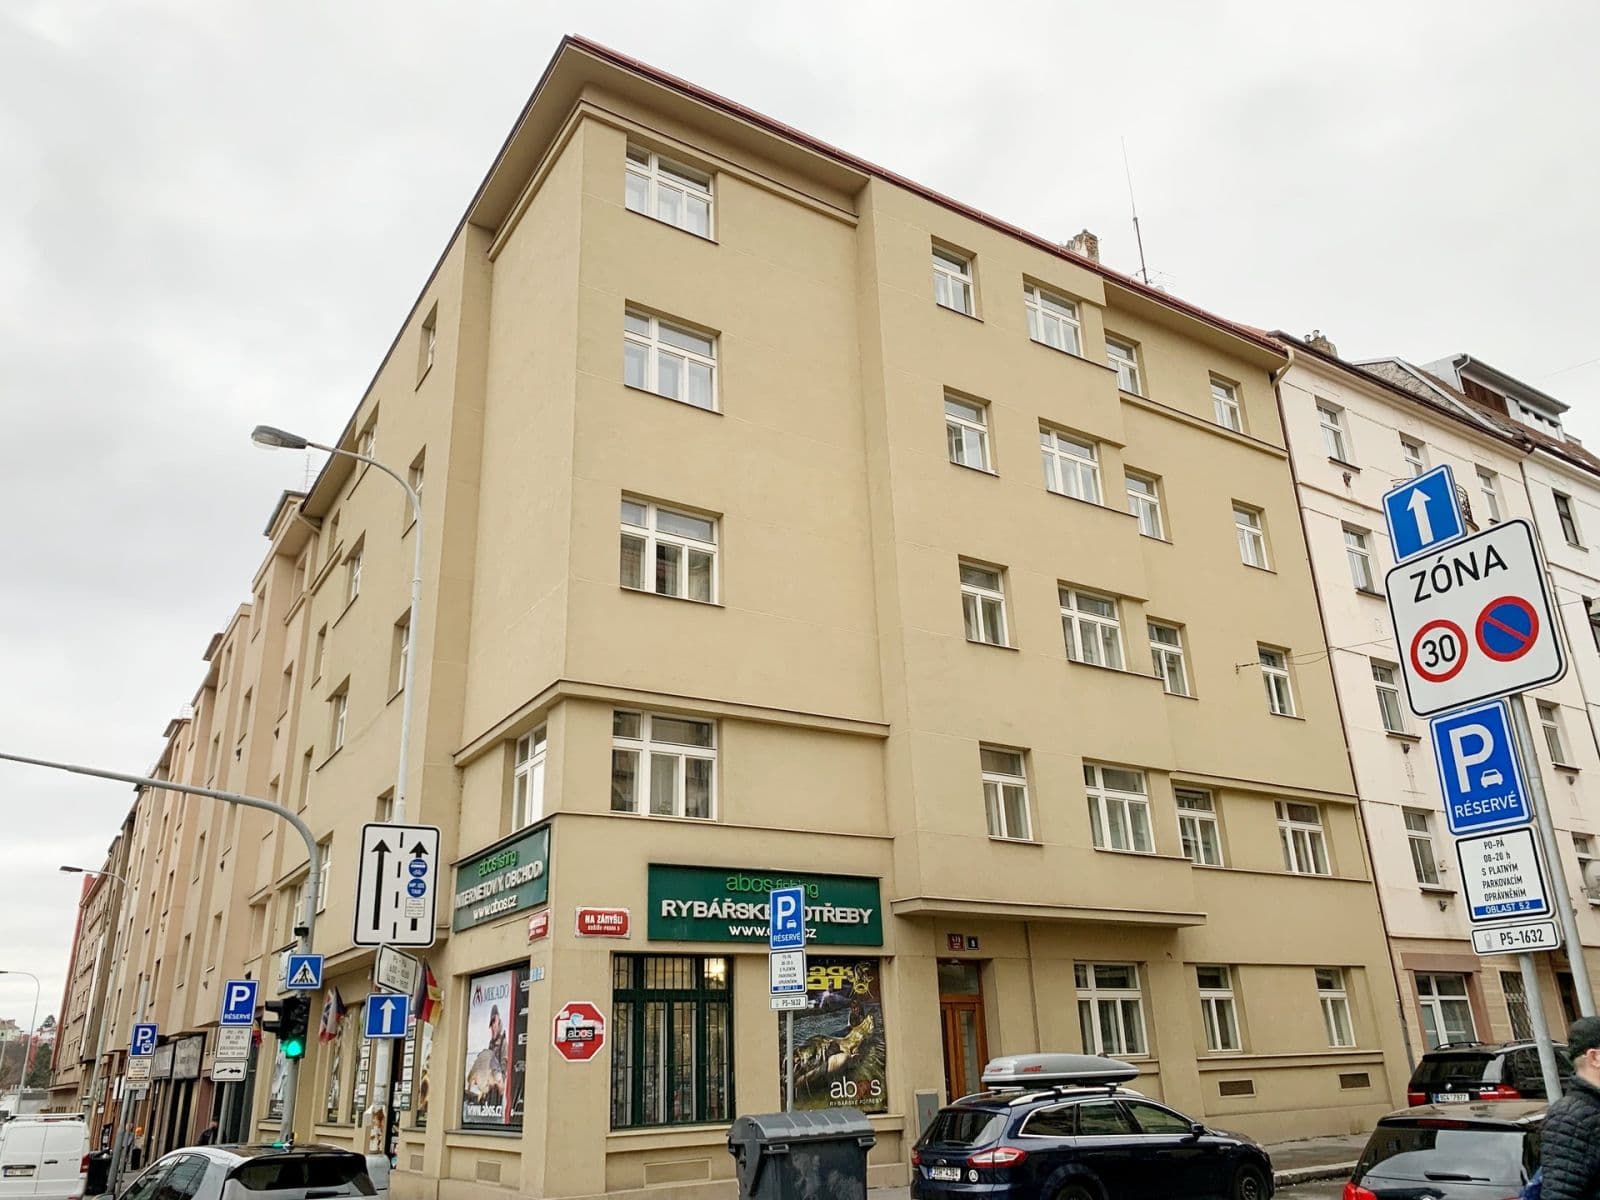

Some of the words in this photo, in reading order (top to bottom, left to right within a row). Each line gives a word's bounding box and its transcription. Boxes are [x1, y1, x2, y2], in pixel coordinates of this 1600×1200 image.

[1409, 544, 1508, 603] ZÓNA
[1421, 633, 1457, 668] 30
[1449, 723, 1495, 793] P
[1454, 790, 1519, 818] RÉSERVÉ
[505, 860, 544, 889] OBCHOD
[1481, 867, 1487, 876] S
[1488, 863, 1519, 875] PLATNÝM
[726, 873, 773, 893] abos
[1482, 876, 1523, 889] PARKOVACÍM
[777, 896, 797, 930] P
[1485, 903, 1516, 914] OBLAST
[1519, 901, 1531, 911] 5.2
[584, 914, 595, 924] NA
[774, 931, 801, 942] RÉSERVÉ
[1500, 928, 1544, 946] P5-1632
[229, 985, 251, 1011] P
[136, 1027, 153, 1047] P
[567, 1026, 593, 1038] abos
[830, 1075, 882, 1099] abos
